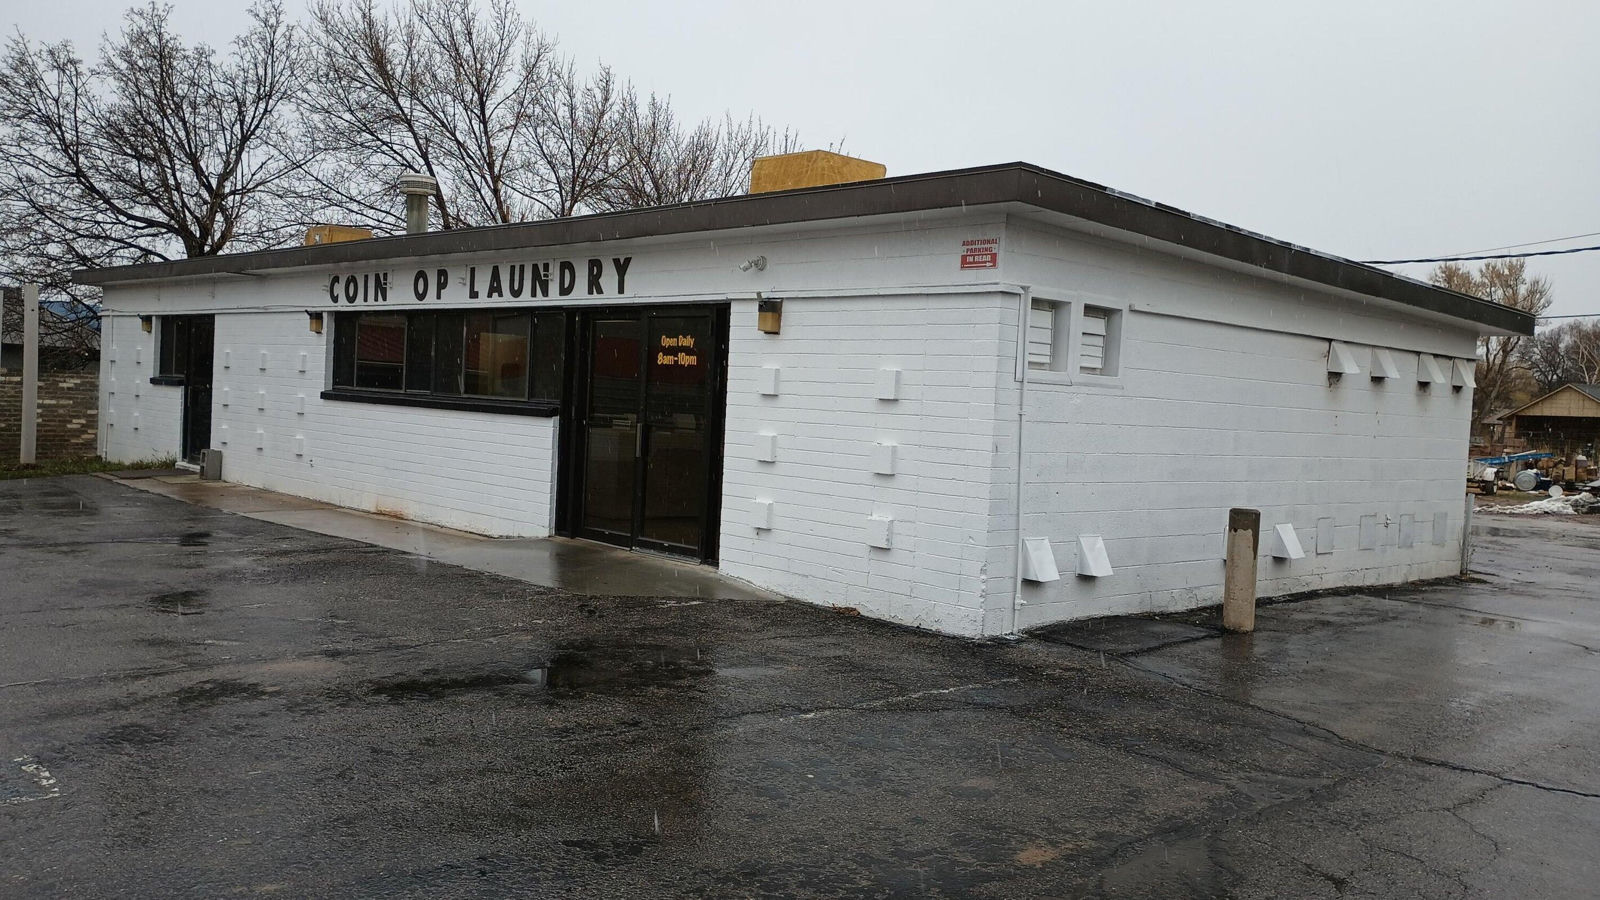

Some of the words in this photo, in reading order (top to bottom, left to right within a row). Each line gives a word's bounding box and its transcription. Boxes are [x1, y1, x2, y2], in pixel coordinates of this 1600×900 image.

[329, 272, 388, 304] COIN
[413, 268, 449, 301] OP
[468, 256, 633, 299] LAUNDRY
[661, 335, 678, 348] Open
[678, 334, 694, 348] Daily
[657, 352, 697, 367] 8am-10pm
